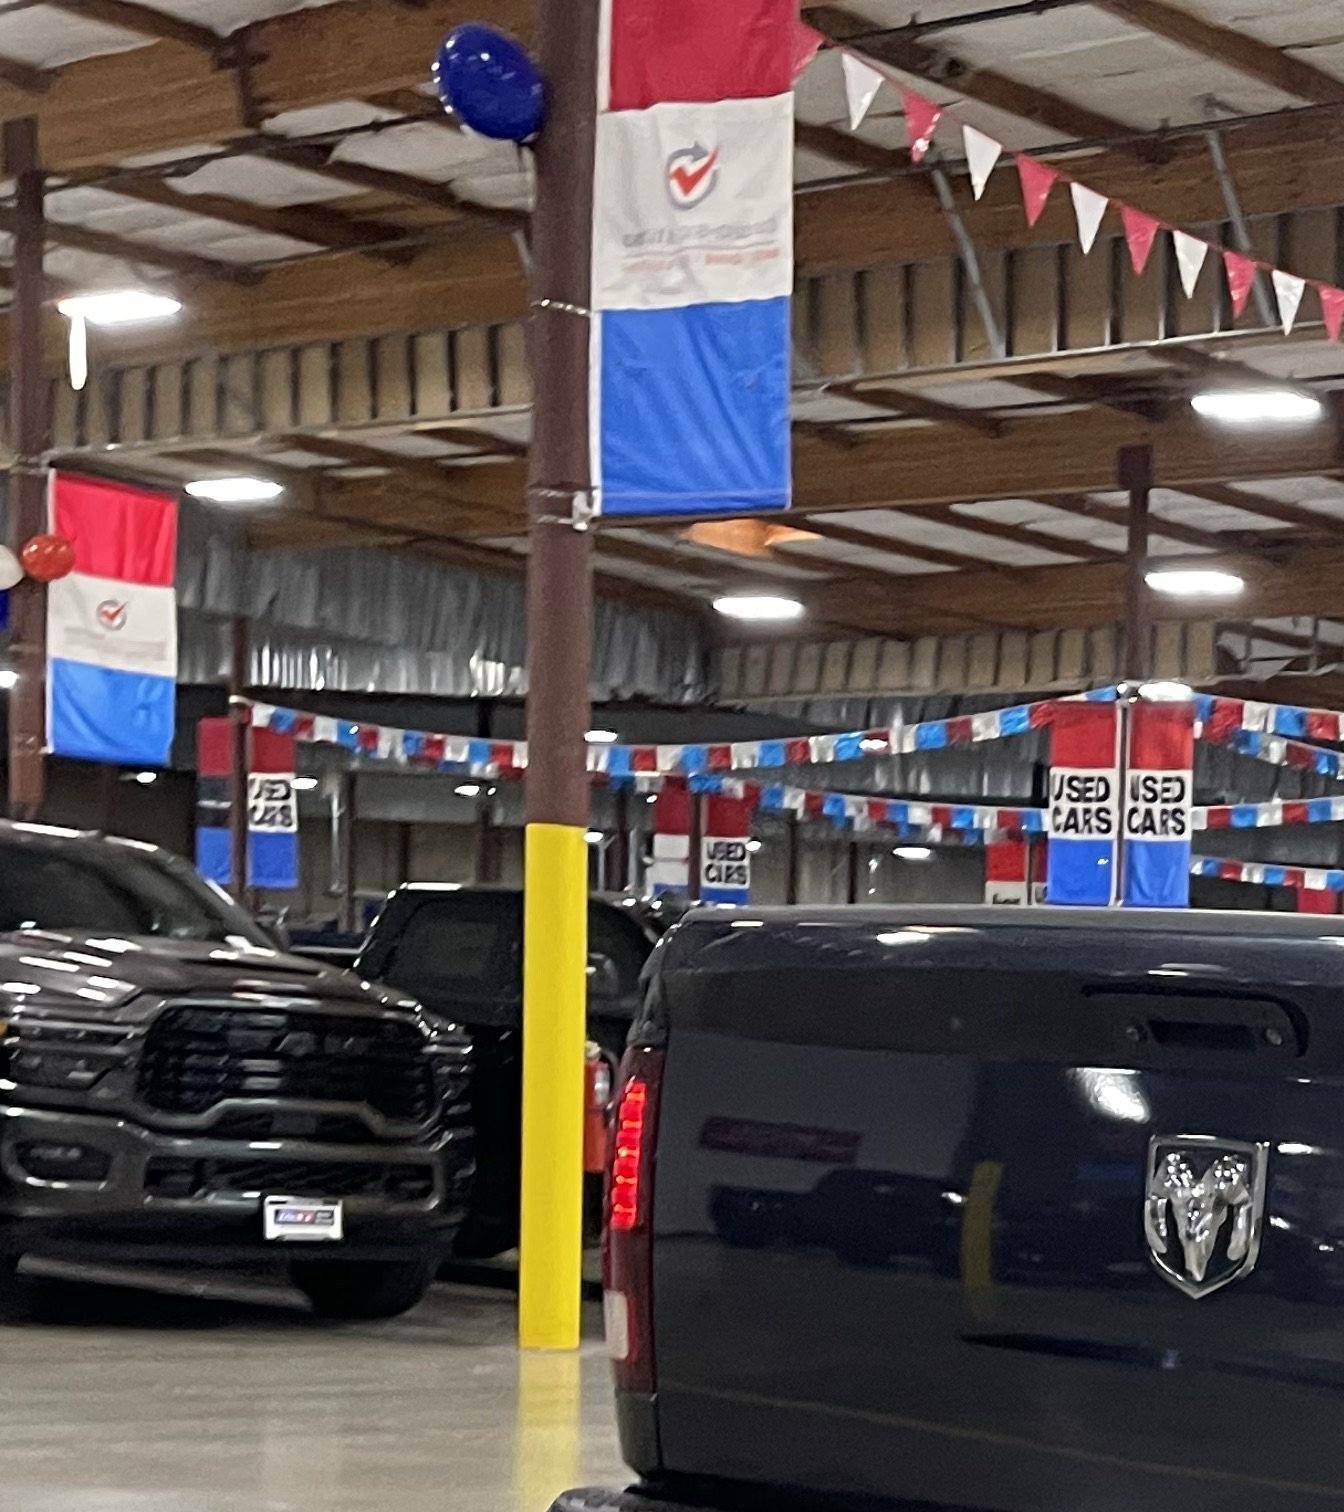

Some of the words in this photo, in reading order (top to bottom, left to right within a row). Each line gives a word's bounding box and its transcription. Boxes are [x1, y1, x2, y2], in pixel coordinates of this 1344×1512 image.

[1052, 775, 1111, 803] USED
[1130, 775, 1186, 804] USED
[1052, 807, 1112, 835] CARS
[1127, 807, 1186, 836] CARS
